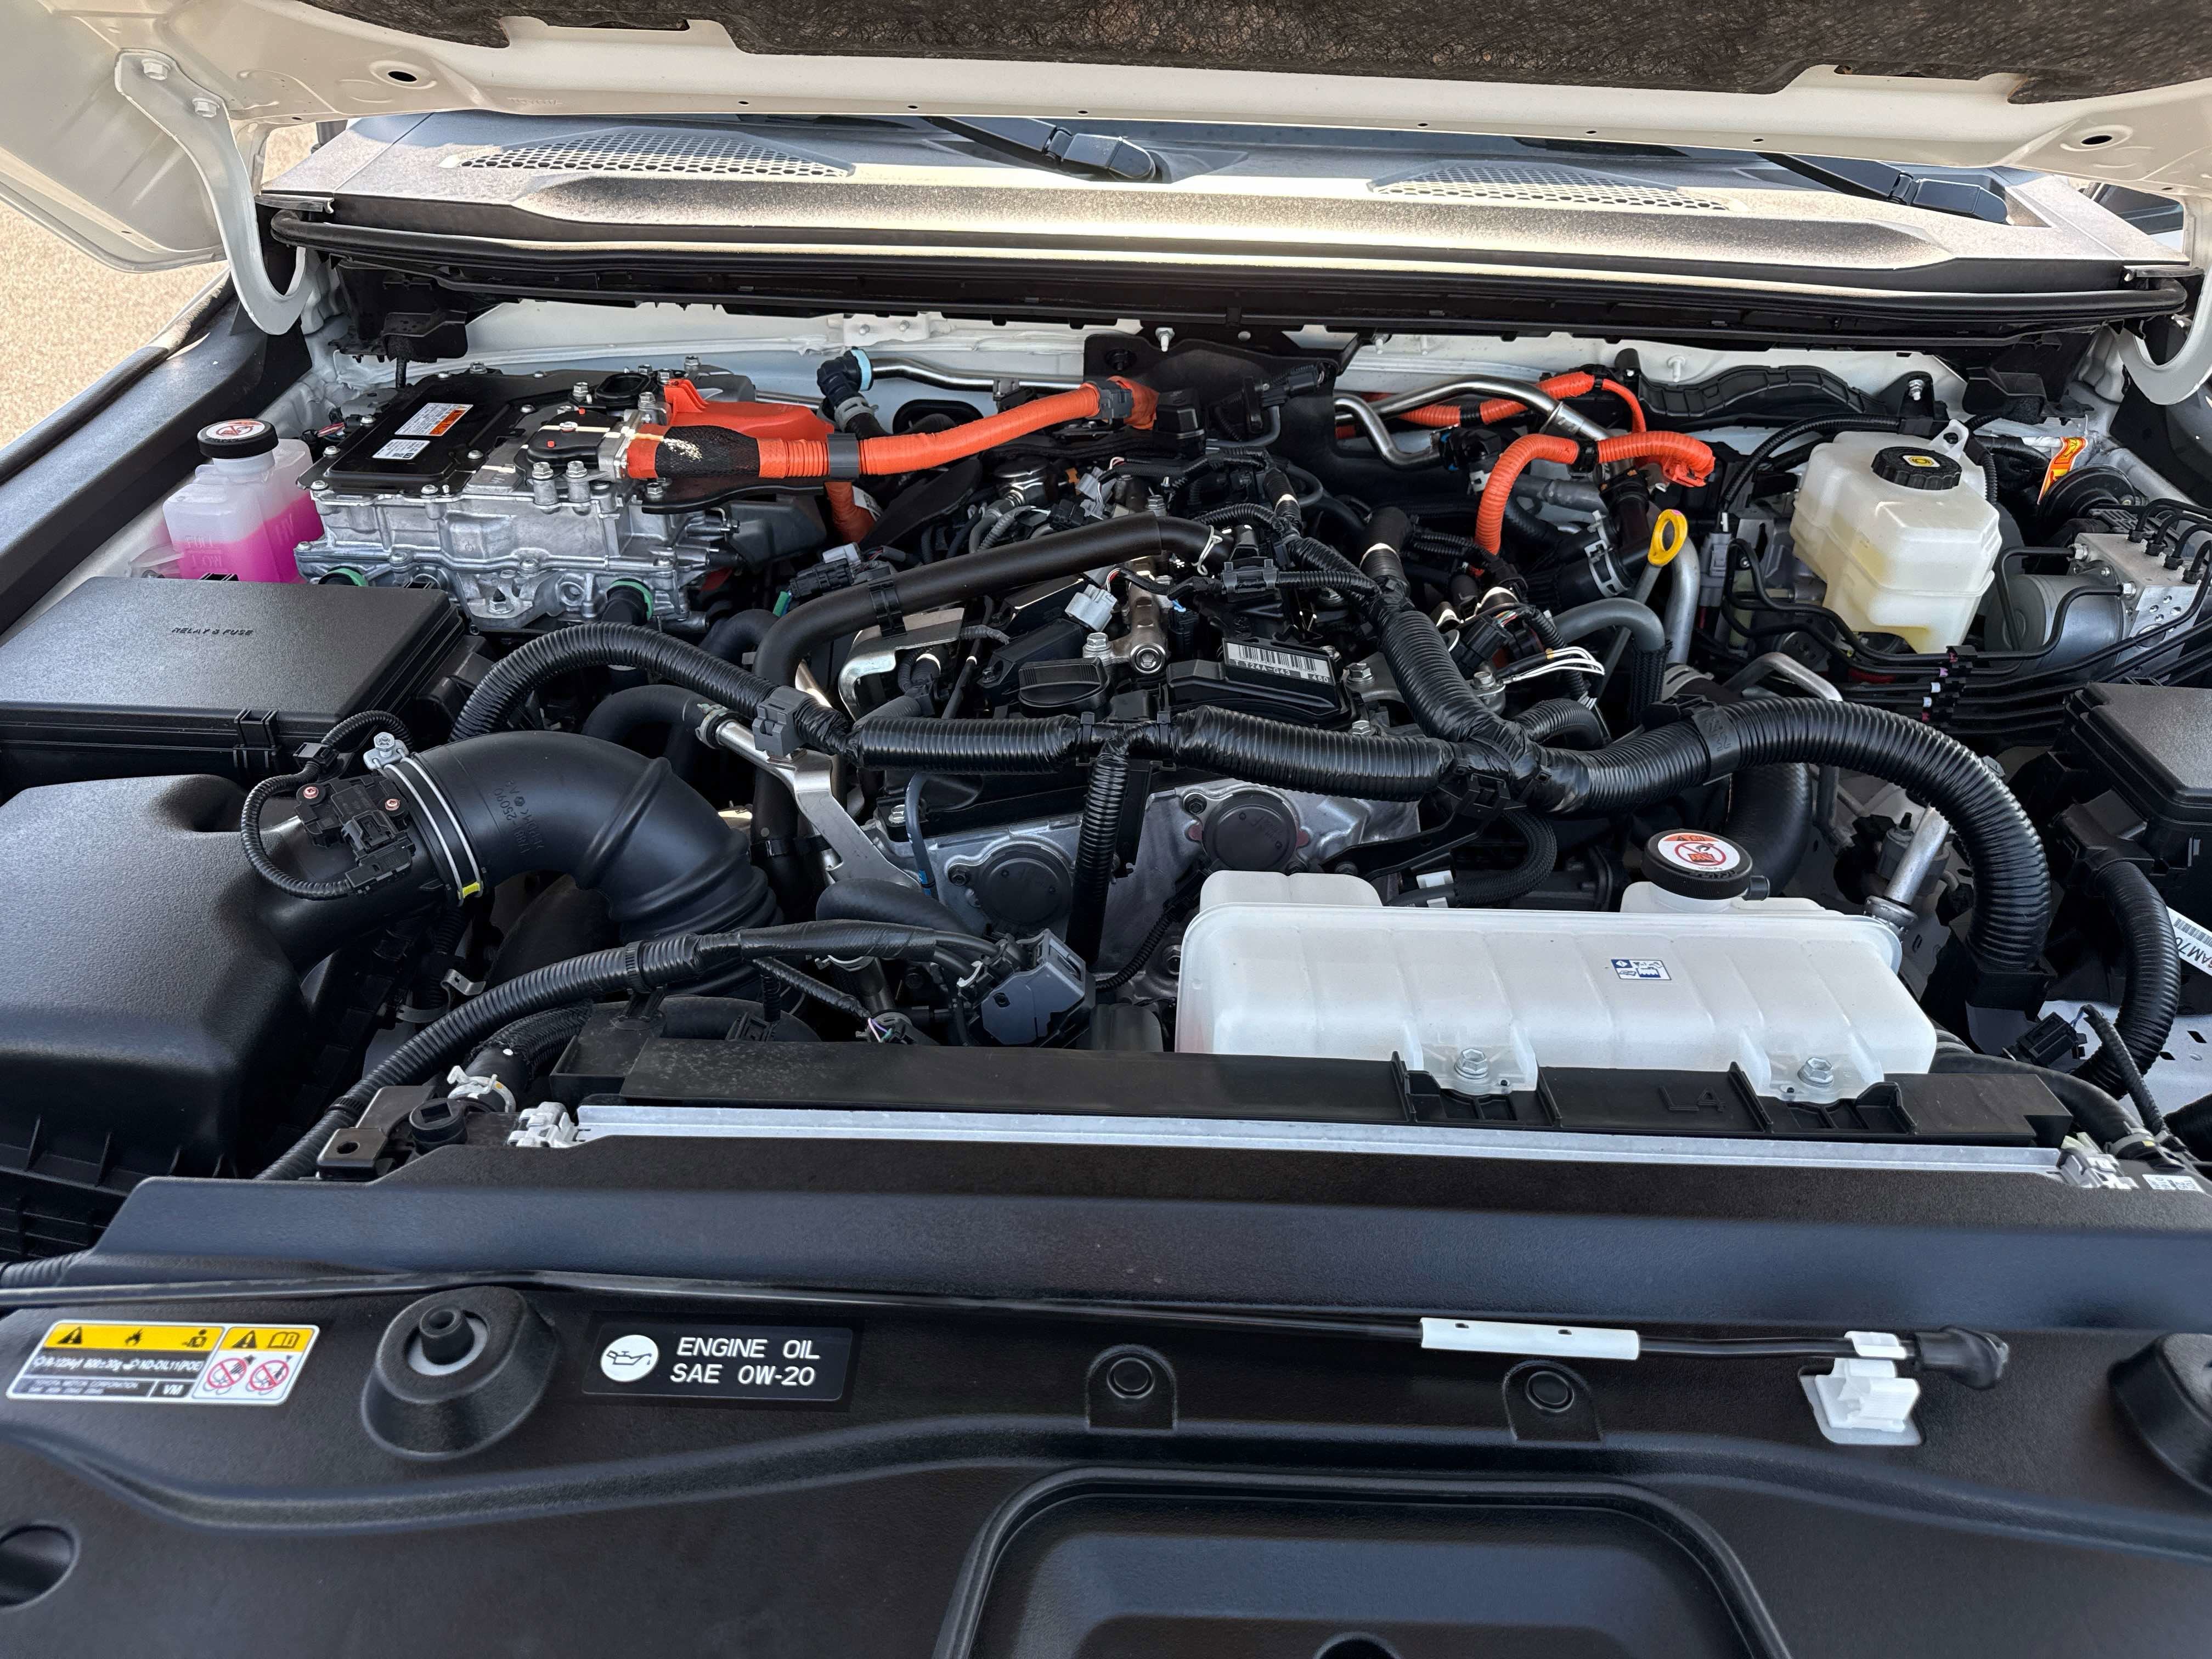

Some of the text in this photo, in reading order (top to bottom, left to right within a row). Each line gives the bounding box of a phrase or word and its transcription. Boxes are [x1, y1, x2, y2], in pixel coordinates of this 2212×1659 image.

[1244, 662, 1291, 676] T24A-G43
[676, 1336, 821, 1360] ENGINE OIL
[670, 1363, 816, 1386] SAE 0W-20
[162, 1384, 185, 1396] VM
